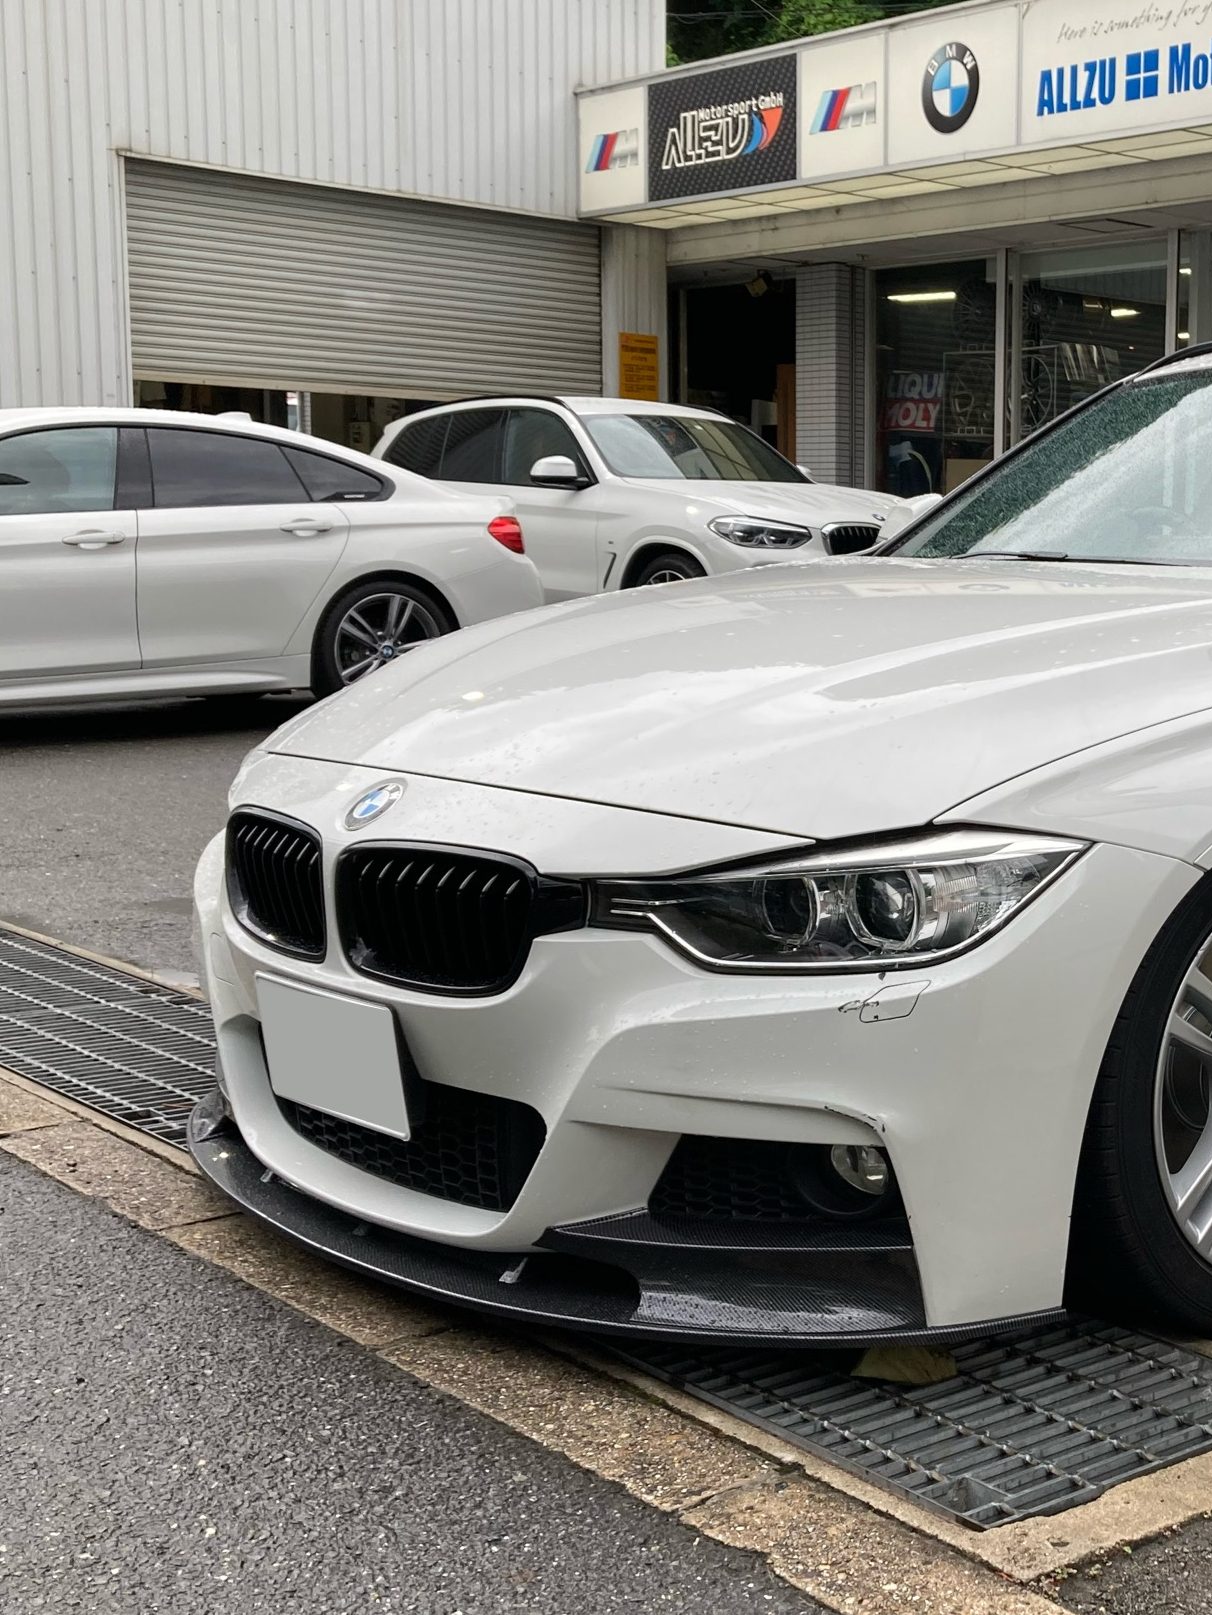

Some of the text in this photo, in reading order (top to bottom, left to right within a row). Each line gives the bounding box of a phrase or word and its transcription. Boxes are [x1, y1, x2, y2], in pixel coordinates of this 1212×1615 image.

[1056, 22, 1087, 43] Here
[1090, 20, 1103, 36] is
[1103, 2, 1172, 31] something
[1173, 0, 1200, 27] for
[926, 43, 977, 76] BMW
[1038, 57, 1117, 116] ALLZU
[698, 91, 784, 121] Motorsport GmbH
